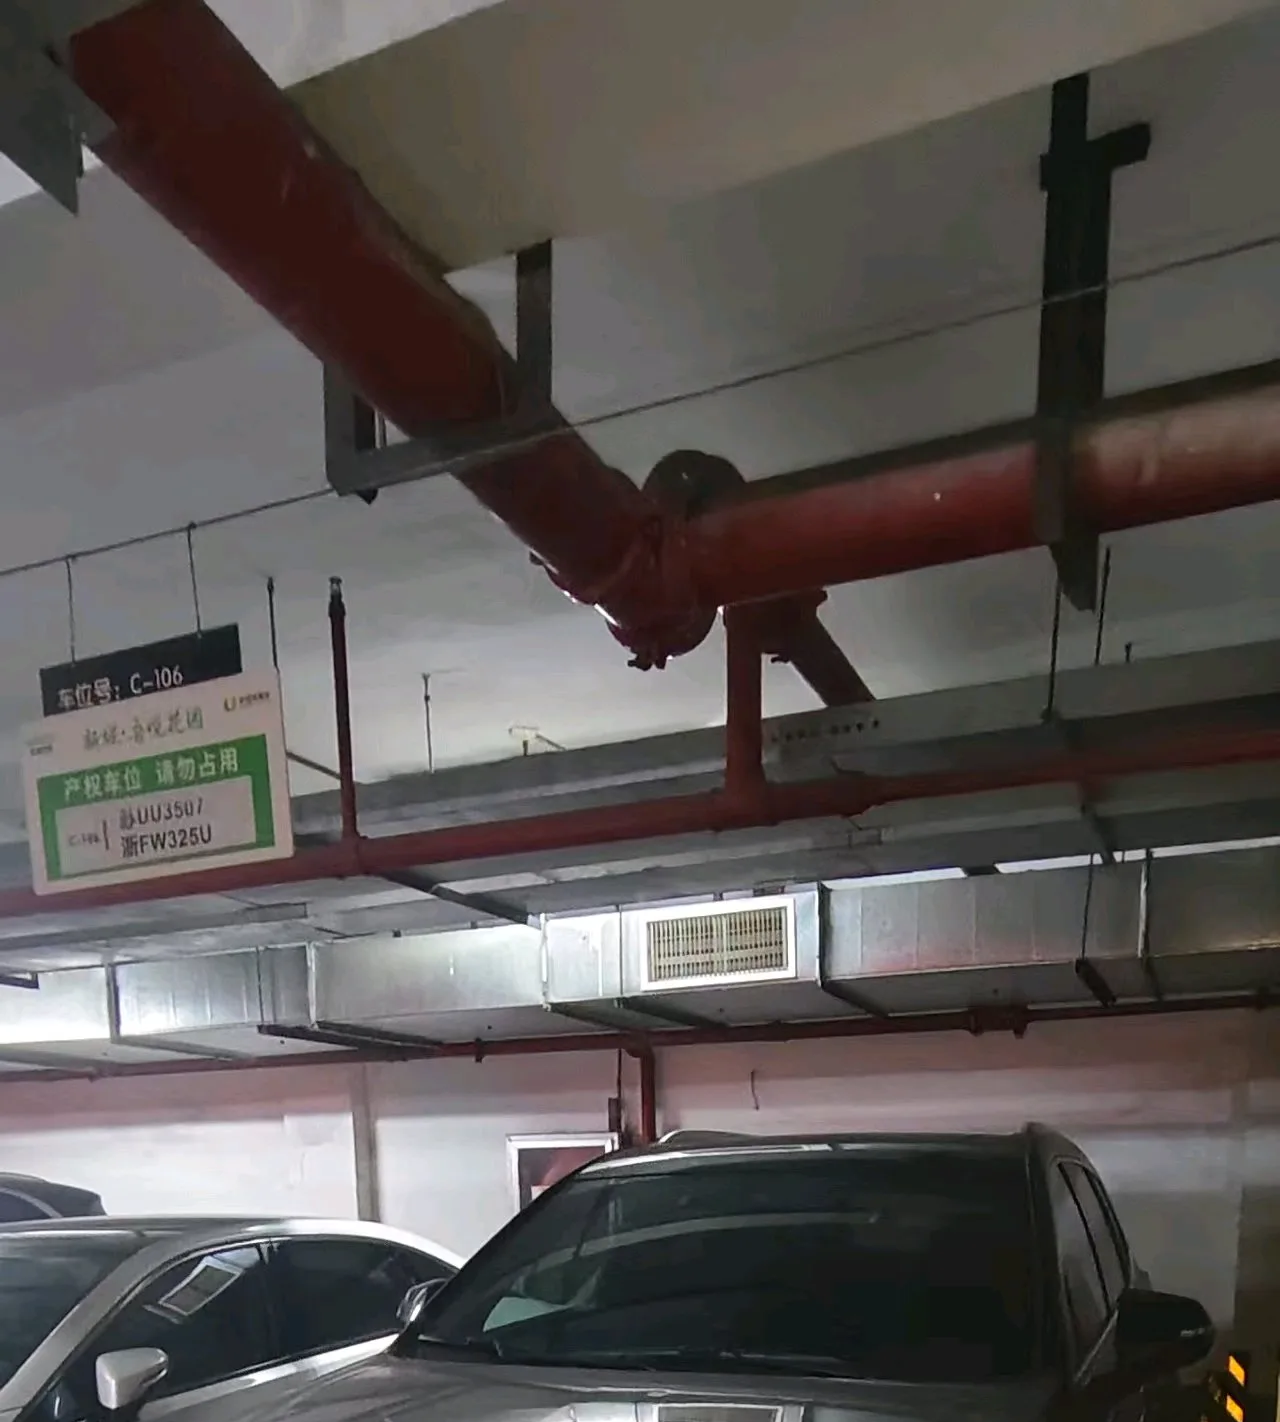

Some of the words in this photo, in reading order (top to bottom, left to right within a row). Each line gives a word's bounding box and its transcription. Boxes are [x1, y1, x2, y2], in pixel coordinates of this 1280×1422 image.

[64, 767, 142, 801] 产权车位
[155, 747, 238, 786] 请勿占用
[120, 824, 213, 858] 浙FW325U
